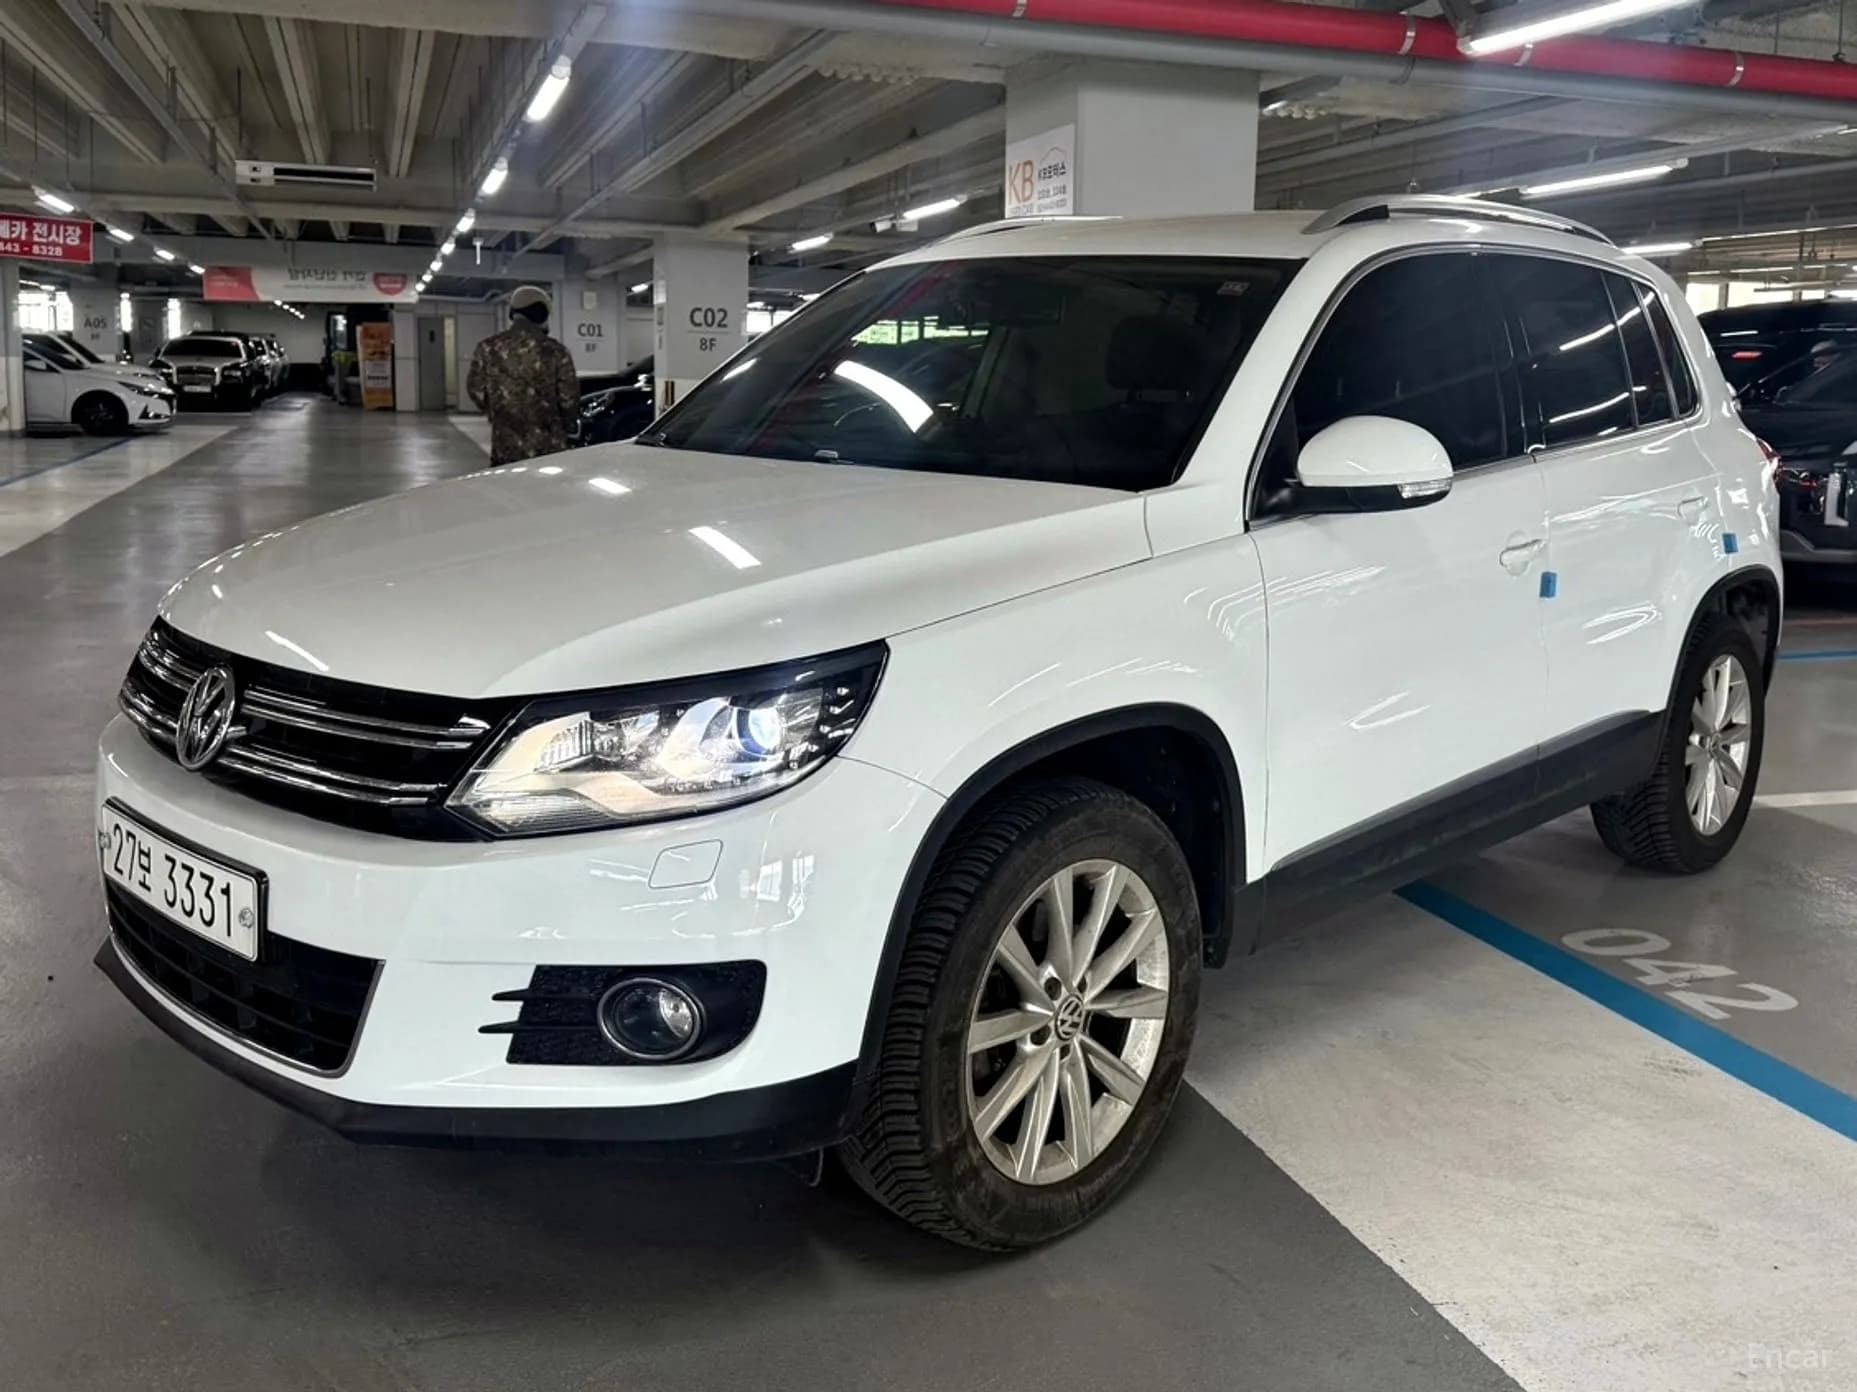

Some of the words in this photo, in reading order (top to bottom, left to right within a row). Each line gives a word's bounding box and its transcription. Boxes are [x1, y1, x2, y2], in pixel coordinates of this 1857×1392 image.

[1007, 159, 1034, 206] KB
[32, 222, 82, 246] 전시장
[32, 245, 63, 257] 8328
[577, 322, 604, 337] C01
[689, 307, 729, 329] C02
[699, 337, 718, 351] 8F
[113, 823, 152, 893] 27보
[164, 853, 232, 938] 3331
[1561, 928, 1799, 1020] 042
